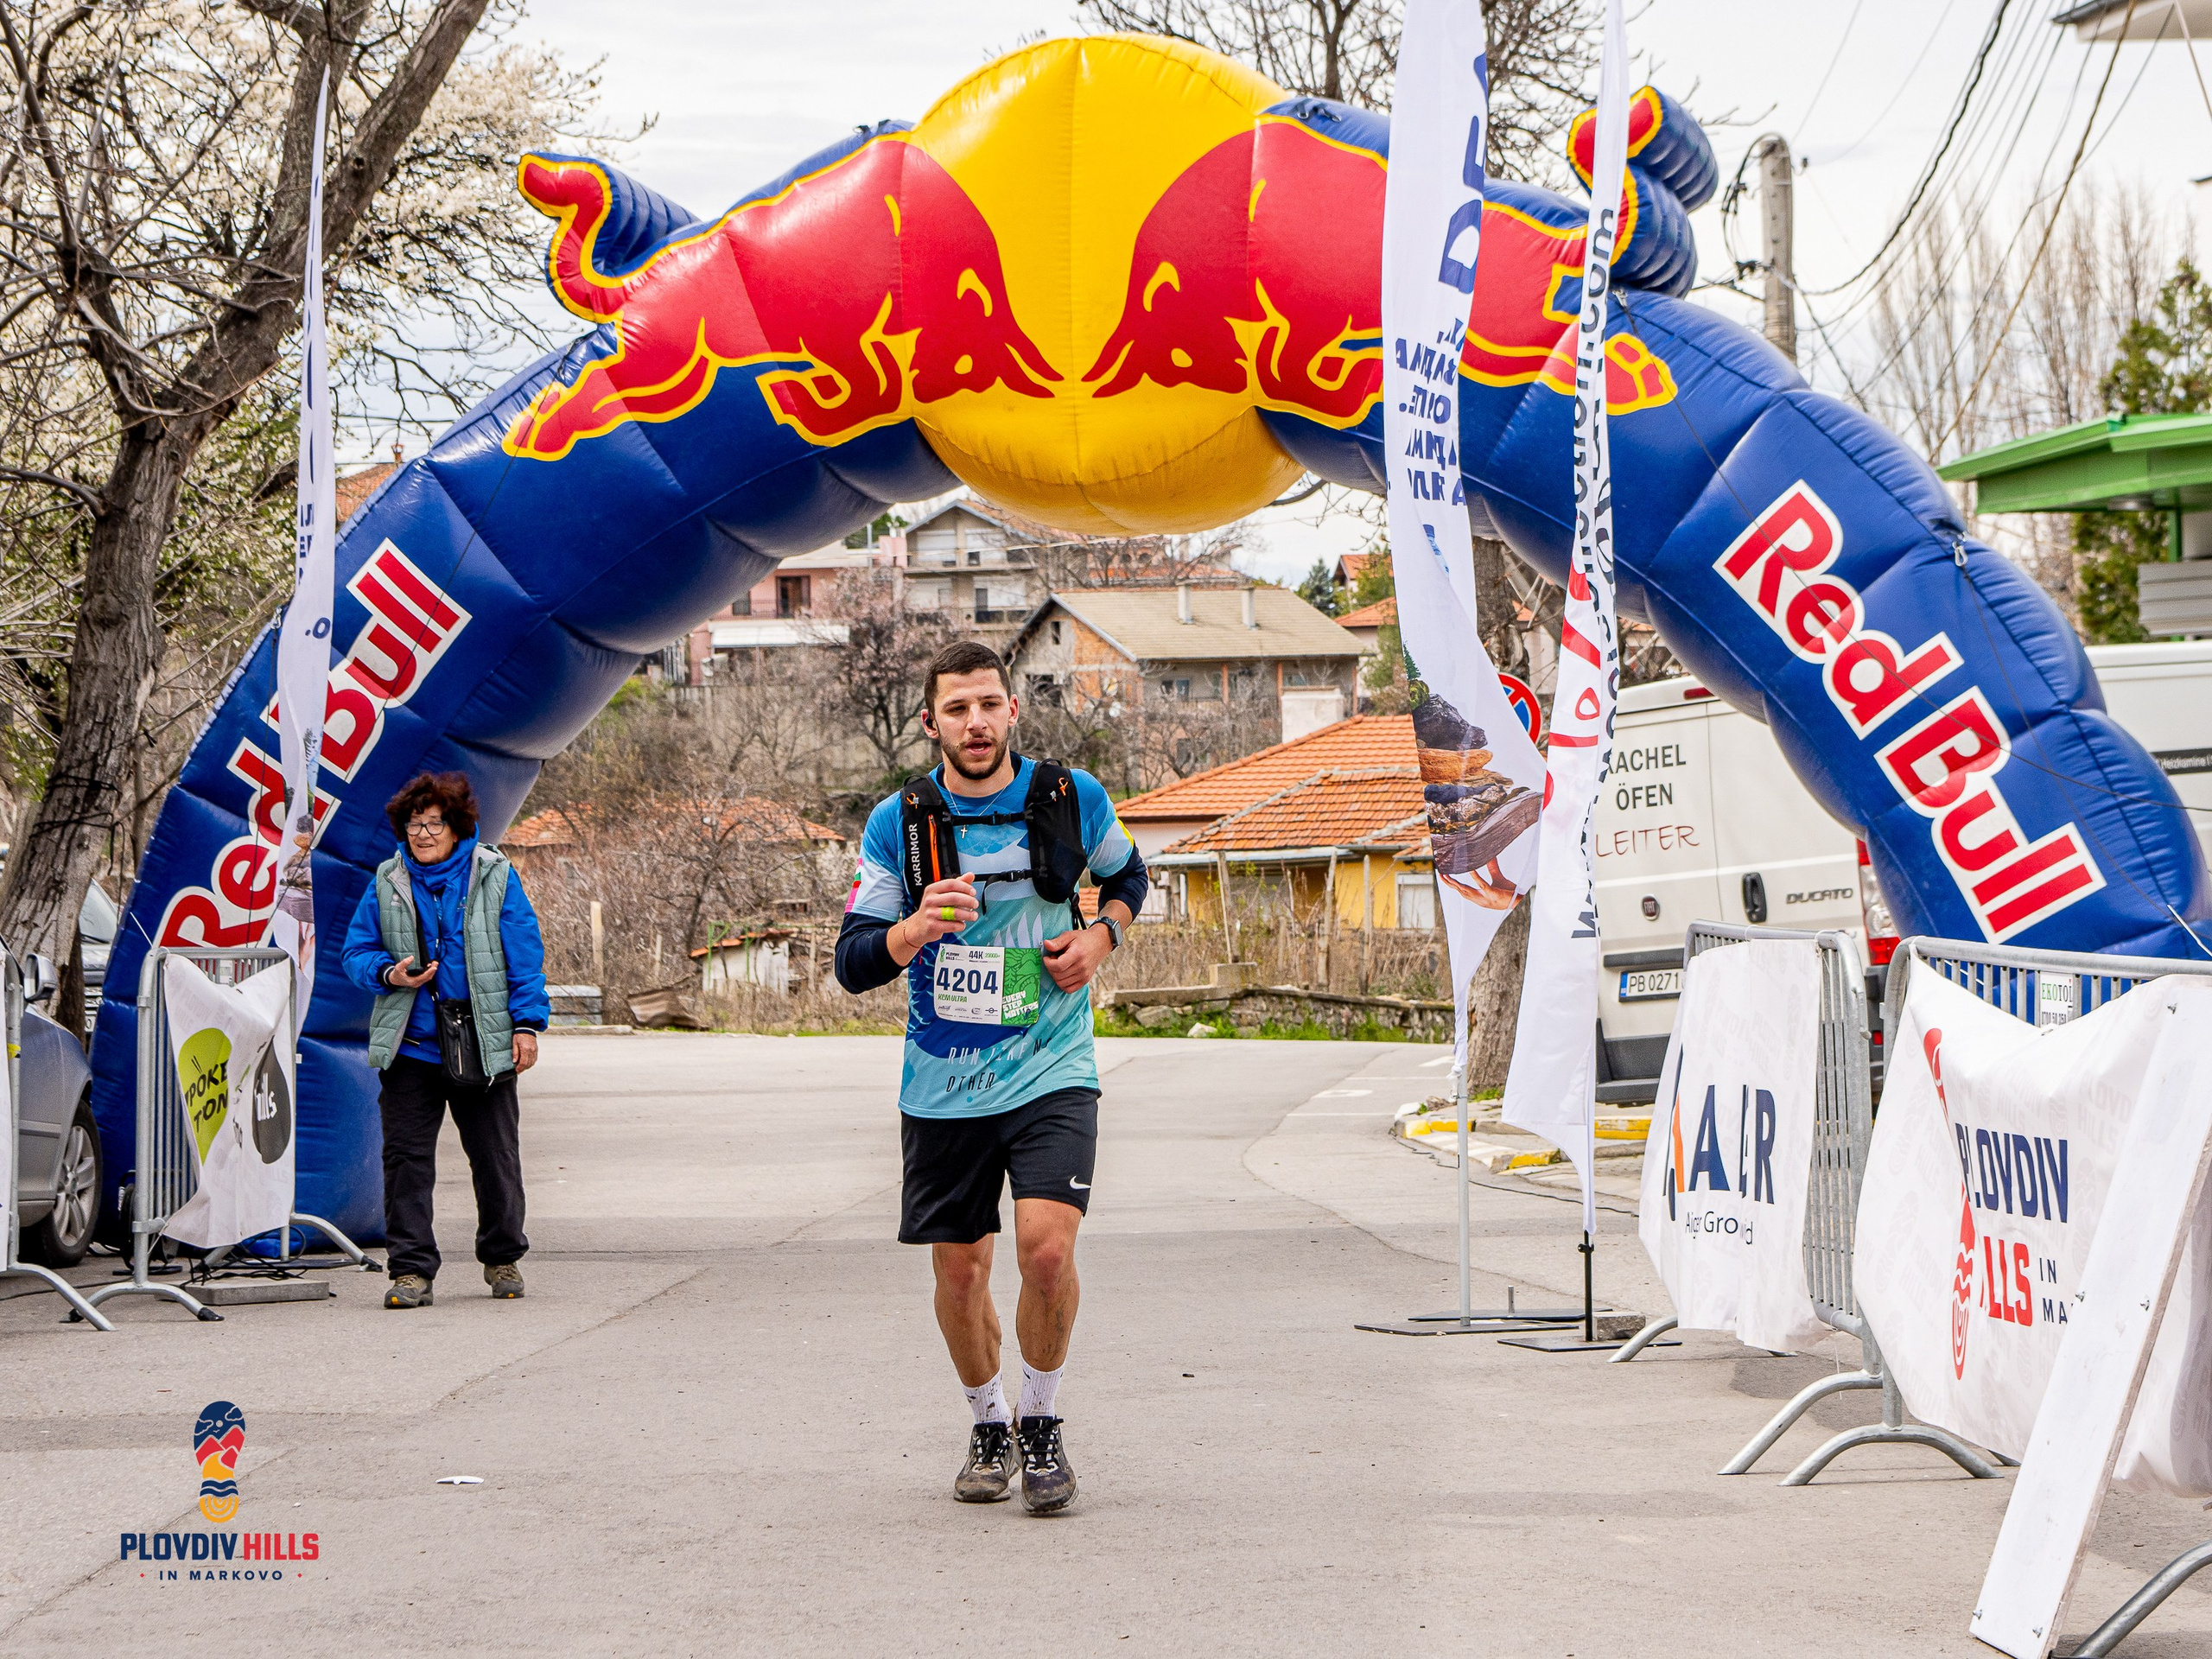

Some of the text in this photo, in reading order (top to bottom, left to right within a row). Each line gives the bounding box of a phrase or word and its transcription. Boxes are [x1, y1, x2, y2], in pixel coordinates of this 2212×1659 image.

[269, 550, 460, 771] Bull
[1725, 492, 2094, 932] Red Bull
[1615, 782, 1674, 811] ÖFEN
[1595, 824, 1700, 858] LEITER
[908, 823, 923, 887] KARRIMOR
[1643, 900, 1656, 913] FIAT
[1785, 887, 1853, 905] DUCATO
[969, 950, 984, 960] 44K
[936, 967, 999, 995] 4204
[1629, 972, 1679, 993] PB 0271
[951, 994, 968, 1003] ULTRA
[1002, 990, 1027, 1005] EVERY
[1002, 1000, 1023, 1013] STEP
[947, 1046, 981, 1065] RUN
[946, 1071, 995, 1092] OTHER
[2039, 1256, 2057, 1284] IN
